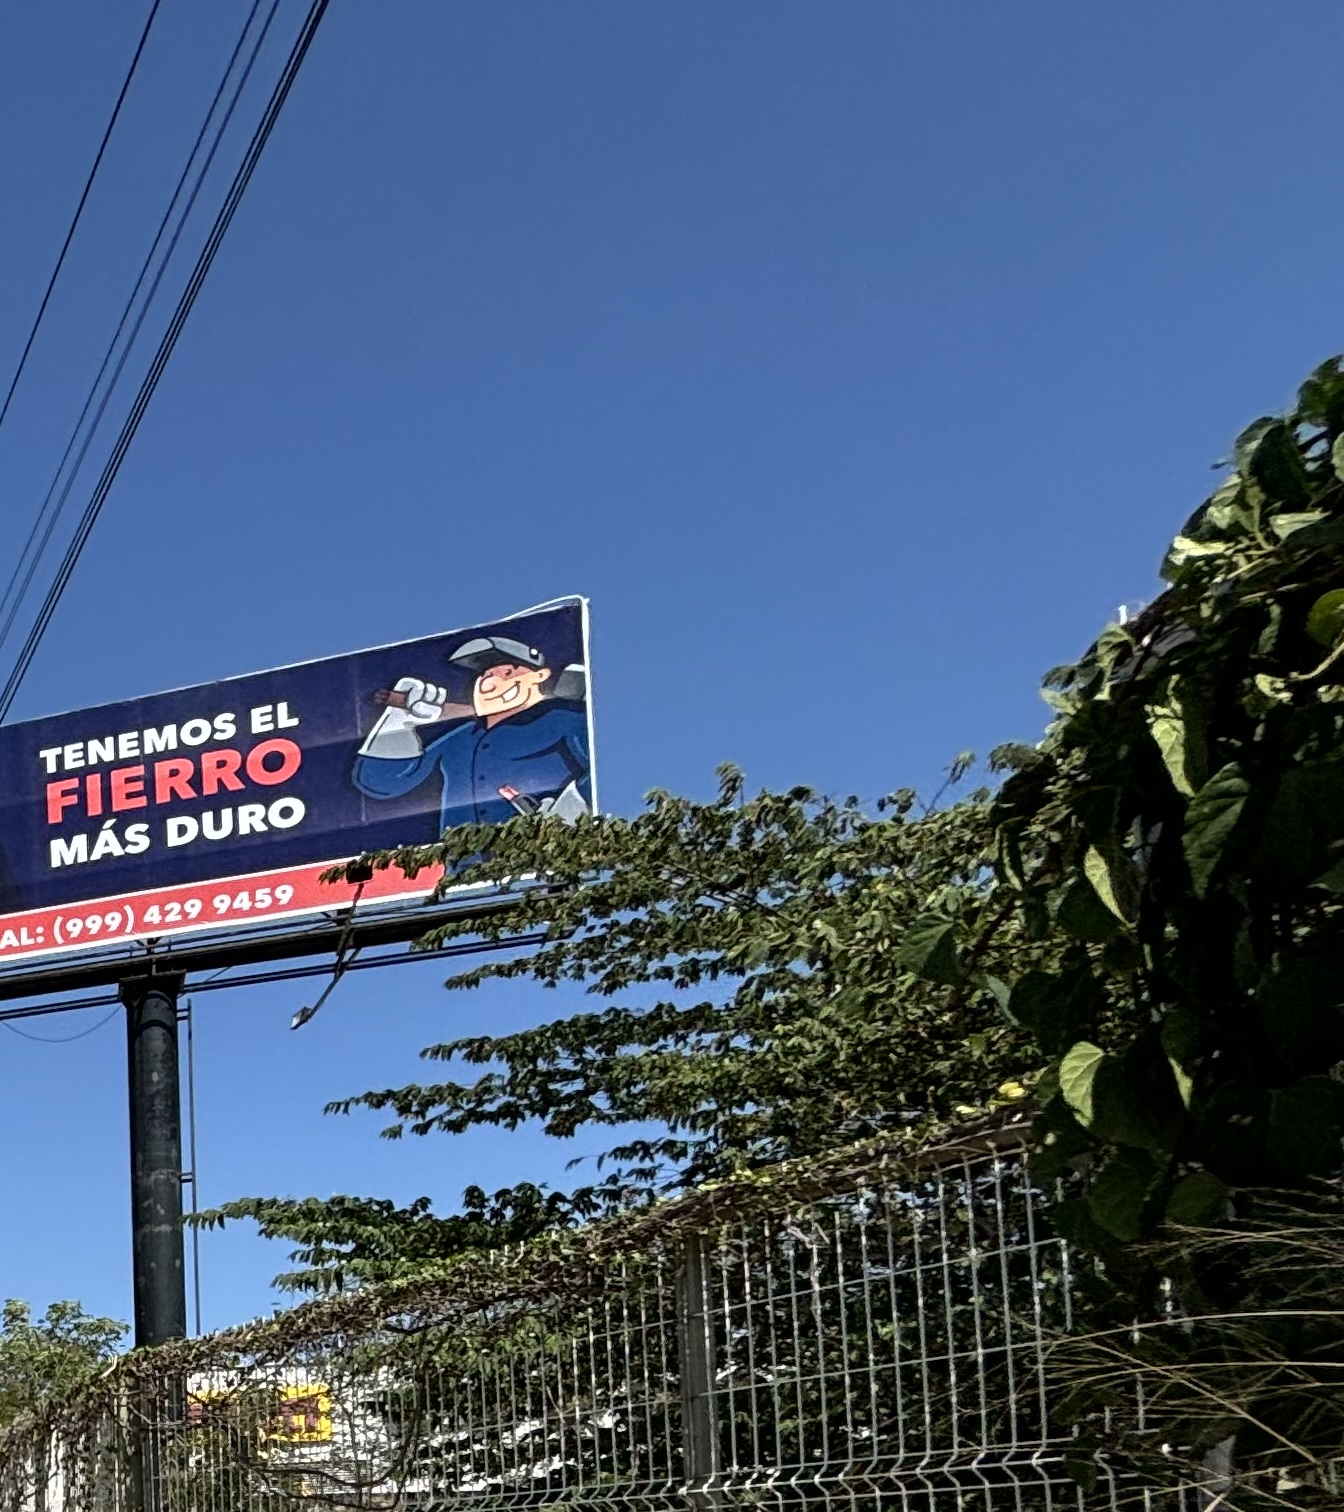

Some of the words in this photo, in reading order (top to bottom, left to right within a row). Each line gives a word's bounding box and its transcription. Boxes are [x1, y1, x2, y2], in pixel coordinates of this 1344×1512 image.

[39, 712, 236, 774] TENEMOS
[250, 701, 300, 734] EL
[46, 738, 302, 825] FIERRO
[50, 818, 151, 869] MÁS
[166, 797, 305, 847] DURO
[53, 904, 135, 944] (999)
[143, 898, 203, 925] 429
[212, 884, 294, 915] 9459
